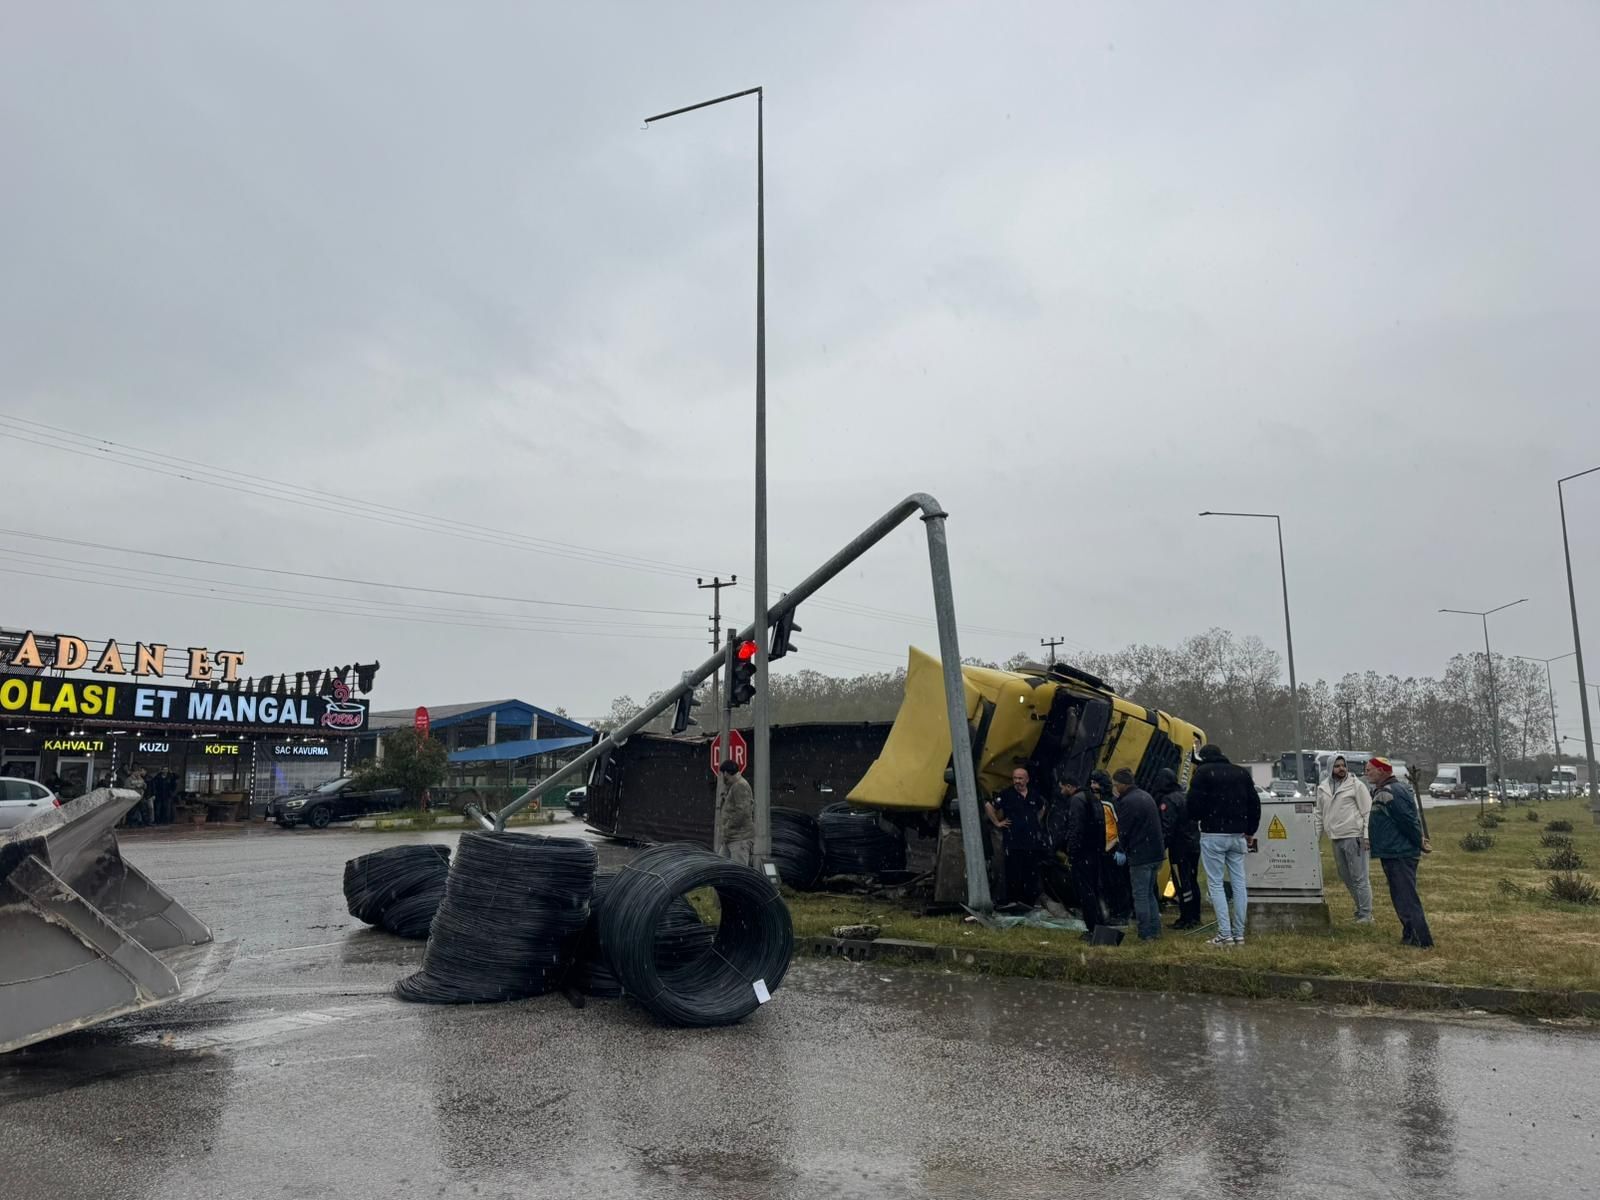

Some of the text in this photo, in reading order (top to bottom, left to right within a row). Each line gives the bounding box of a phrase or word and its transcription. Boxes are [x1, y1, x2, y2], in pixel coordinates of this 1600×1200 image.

[0, 630, 244, 682] ADAN ET
[0, 678, 314, 725] OLASI ET MANGAL
[44, 740, 104, 751] KAHVALTI
[139, 742, 170, 752] KUZU
[205, 743, 239, 755] KÖFTE
[293, 746, 329, 756] KAVURMA
[714, 745, 744, 766] DR
